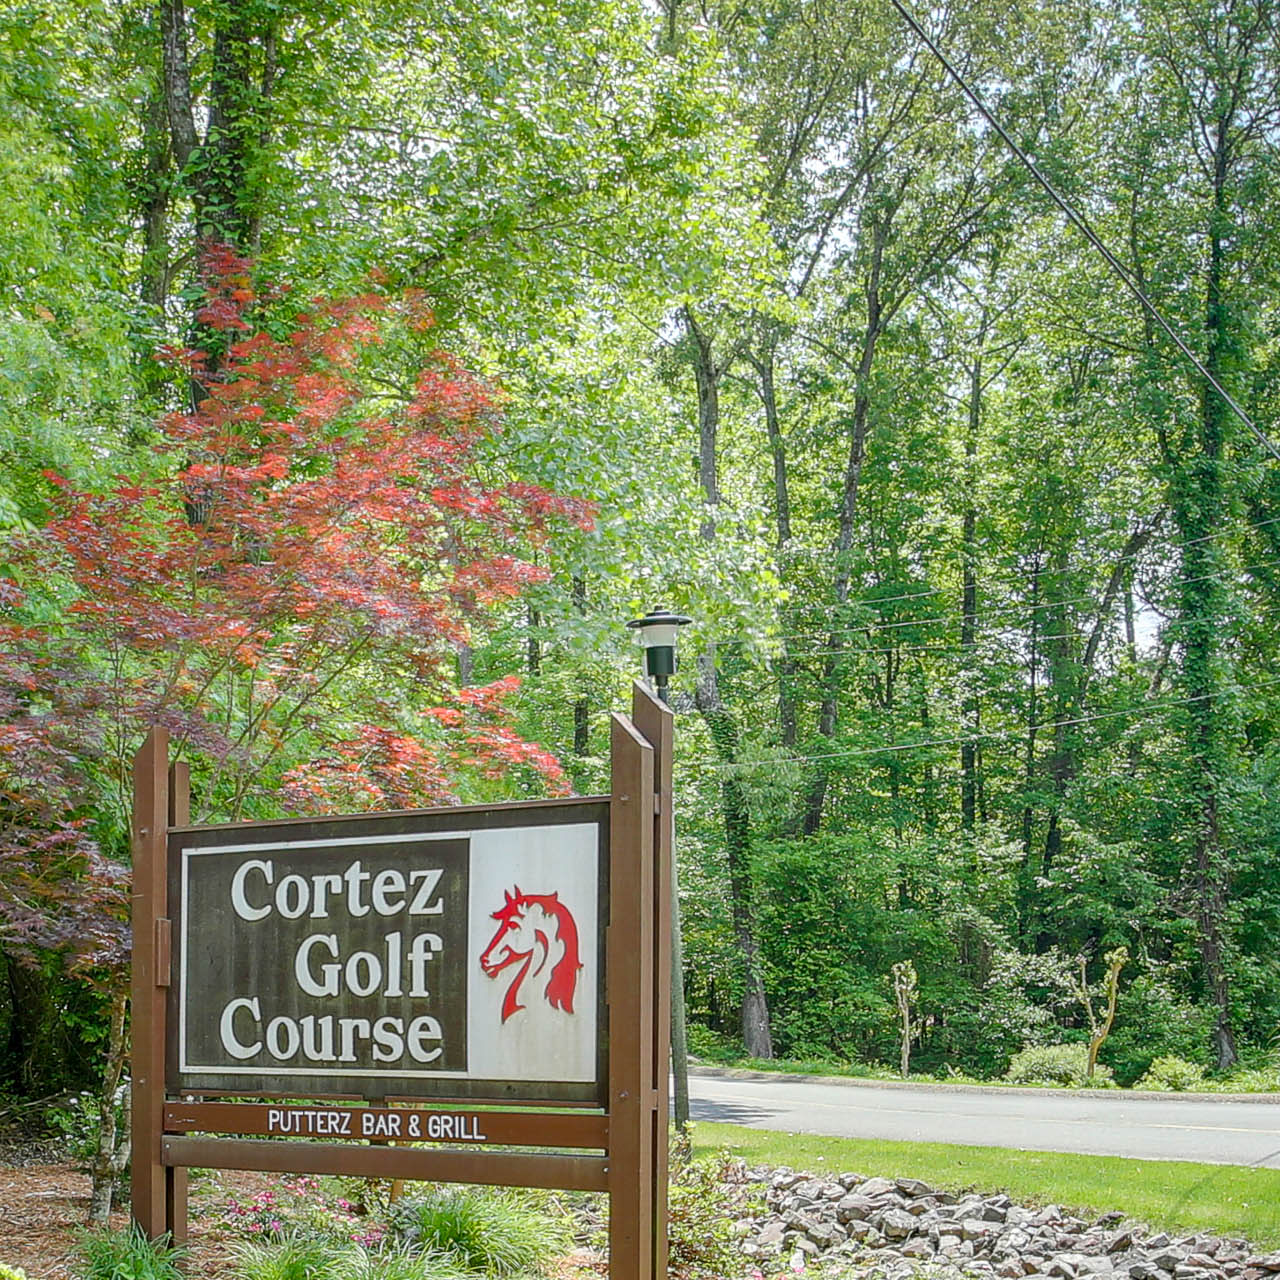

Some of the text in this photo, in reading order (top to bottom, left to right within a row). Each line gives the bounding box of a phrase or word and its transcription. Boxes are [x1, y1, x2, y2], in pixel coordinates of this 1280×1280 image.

[231, 859, 444, 921] Cortez
[295, 931, 443, 997] Golf
[220, 997, 443, 1063] Course
[268, 1109, 486, 1140] PUTTERZ BAR & GRILL
